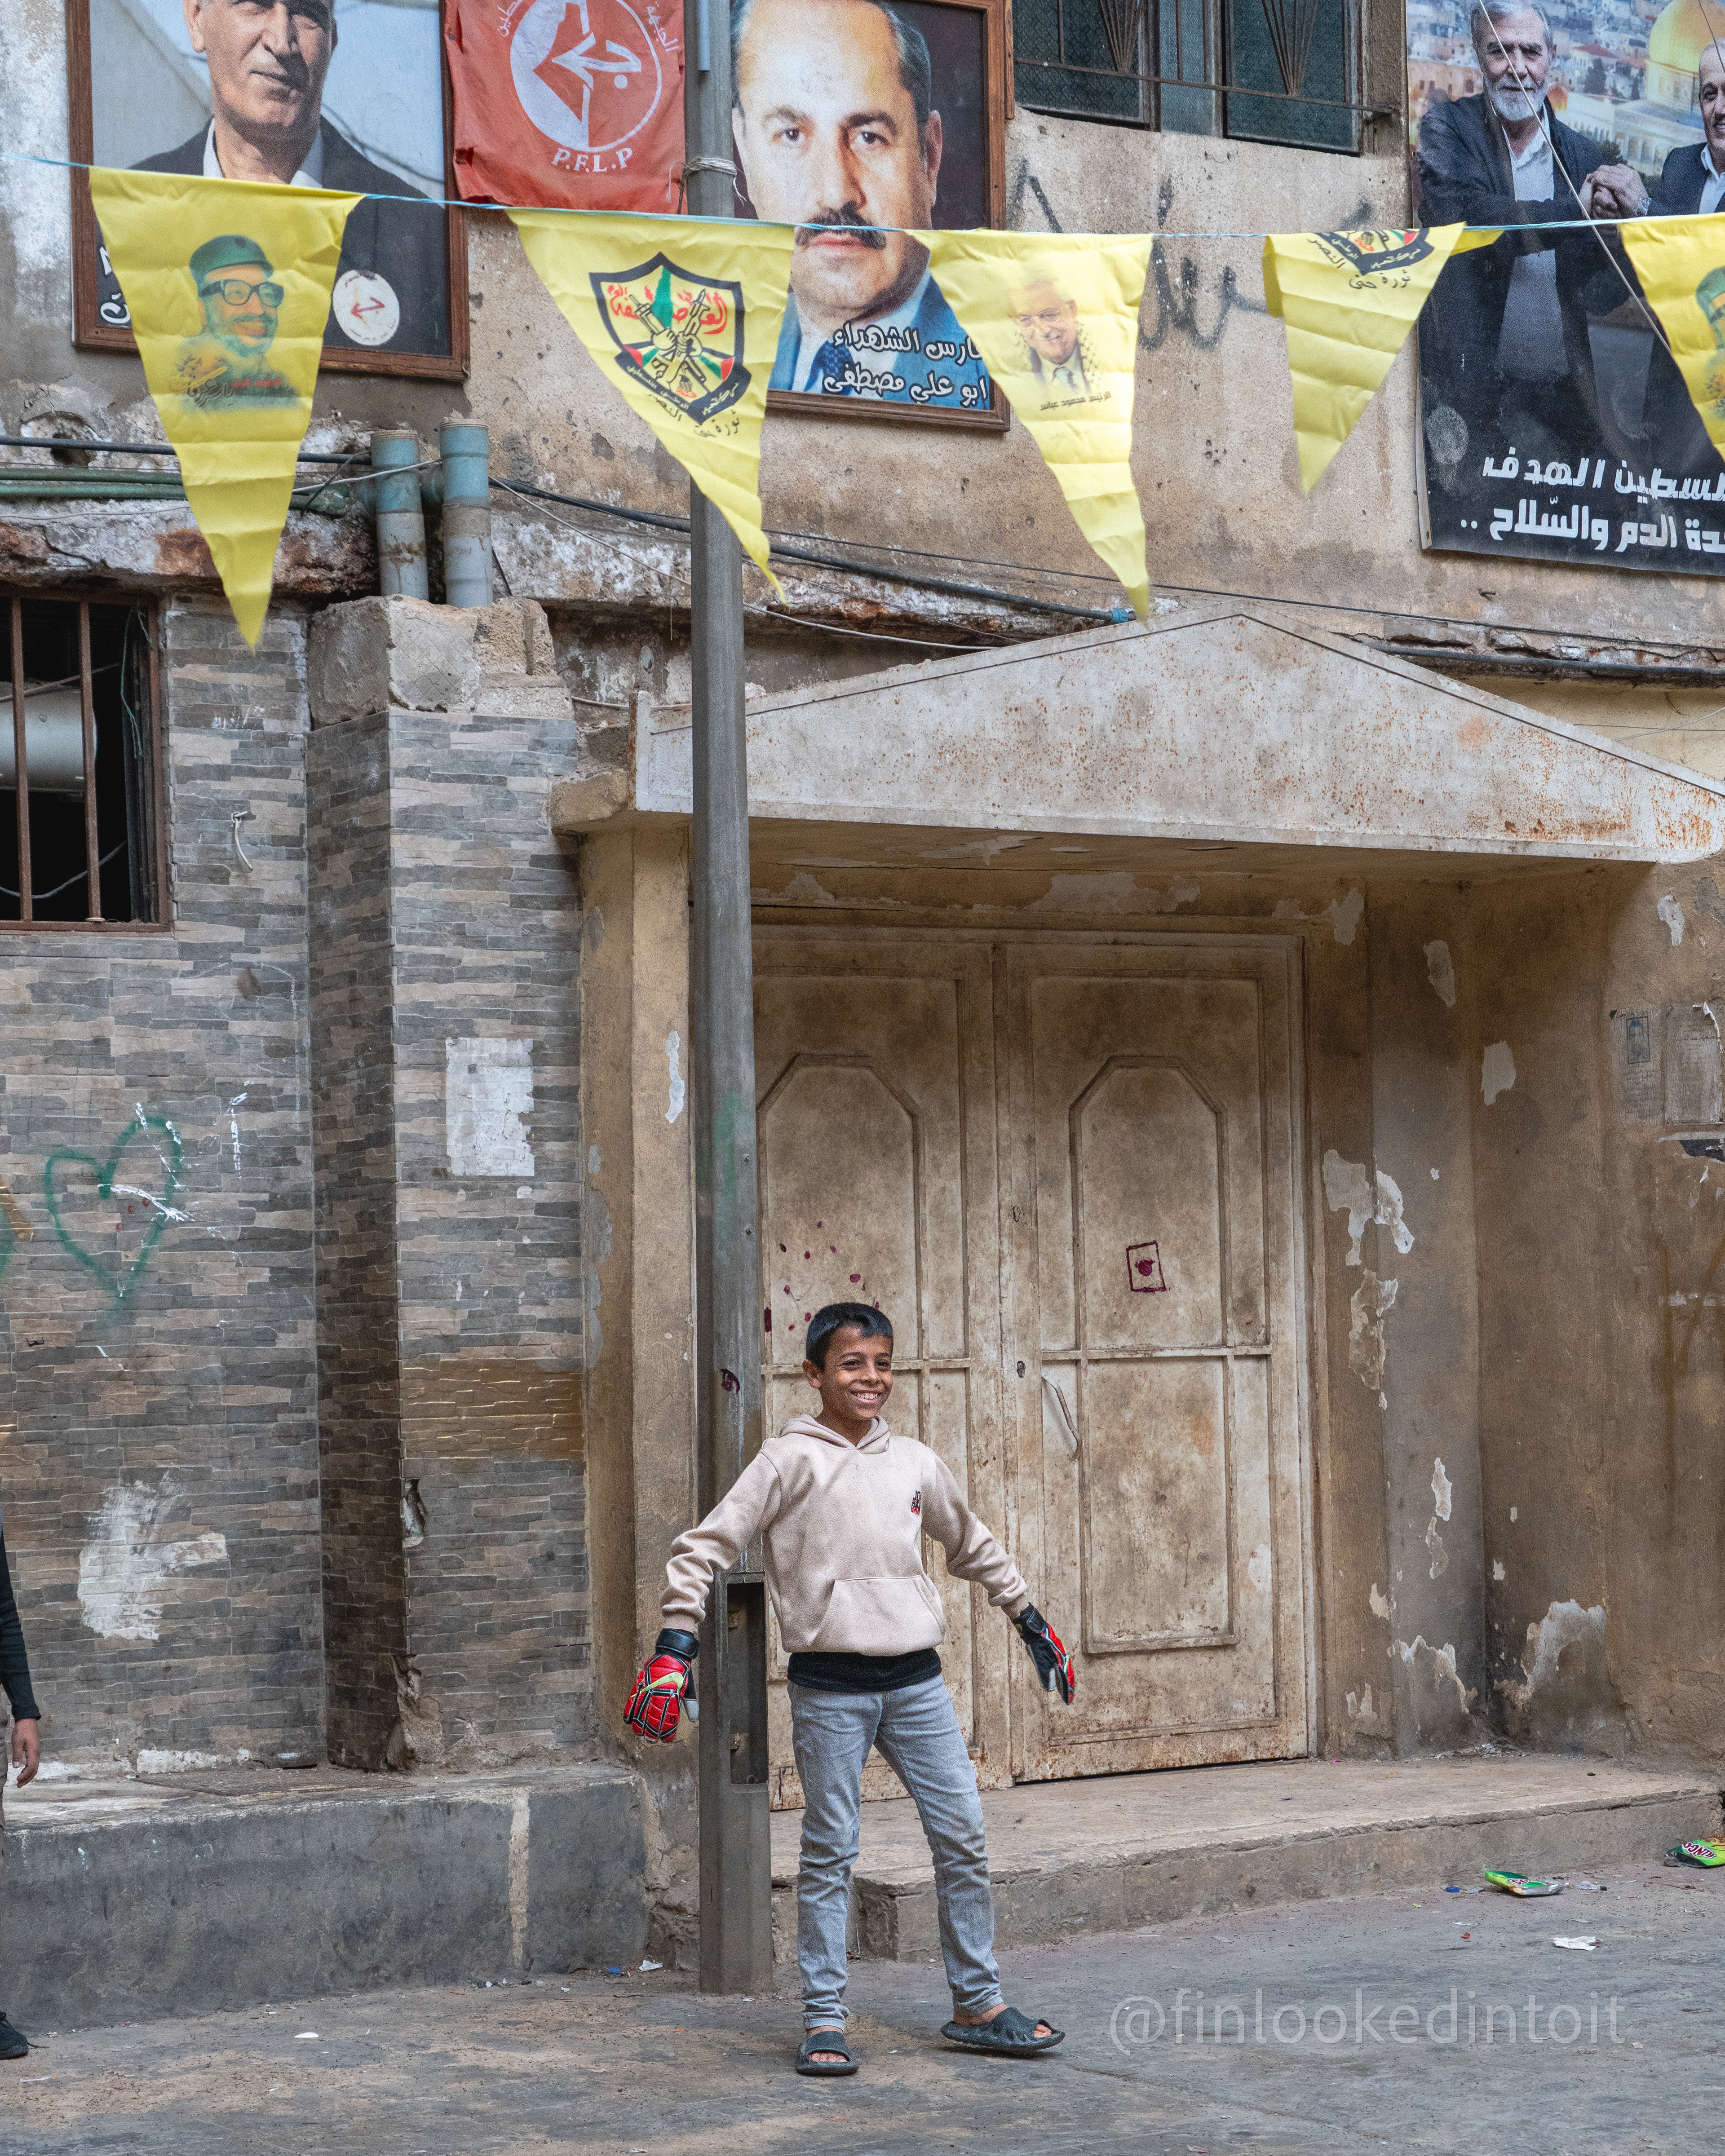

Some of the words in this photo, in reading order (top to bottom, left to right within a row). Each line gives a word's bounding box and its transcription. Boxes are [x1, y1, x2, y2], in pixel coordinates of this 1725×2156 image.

[551, 147, 632, 172] P.F.L.P
[832, 319, 921, 353] الشهداء
[924, 335, 983, 367] ارس
[822, 361, 907, 397] مصطفى
[960, 375, 989, 407] ابو
[1482, 446, 1606, 489] الهدف
[1614, 459, 1725, 504] لسطين
[1614, 514, 1678, 552] الدم
[1682, 1842, 1716, 1858] RINGO
